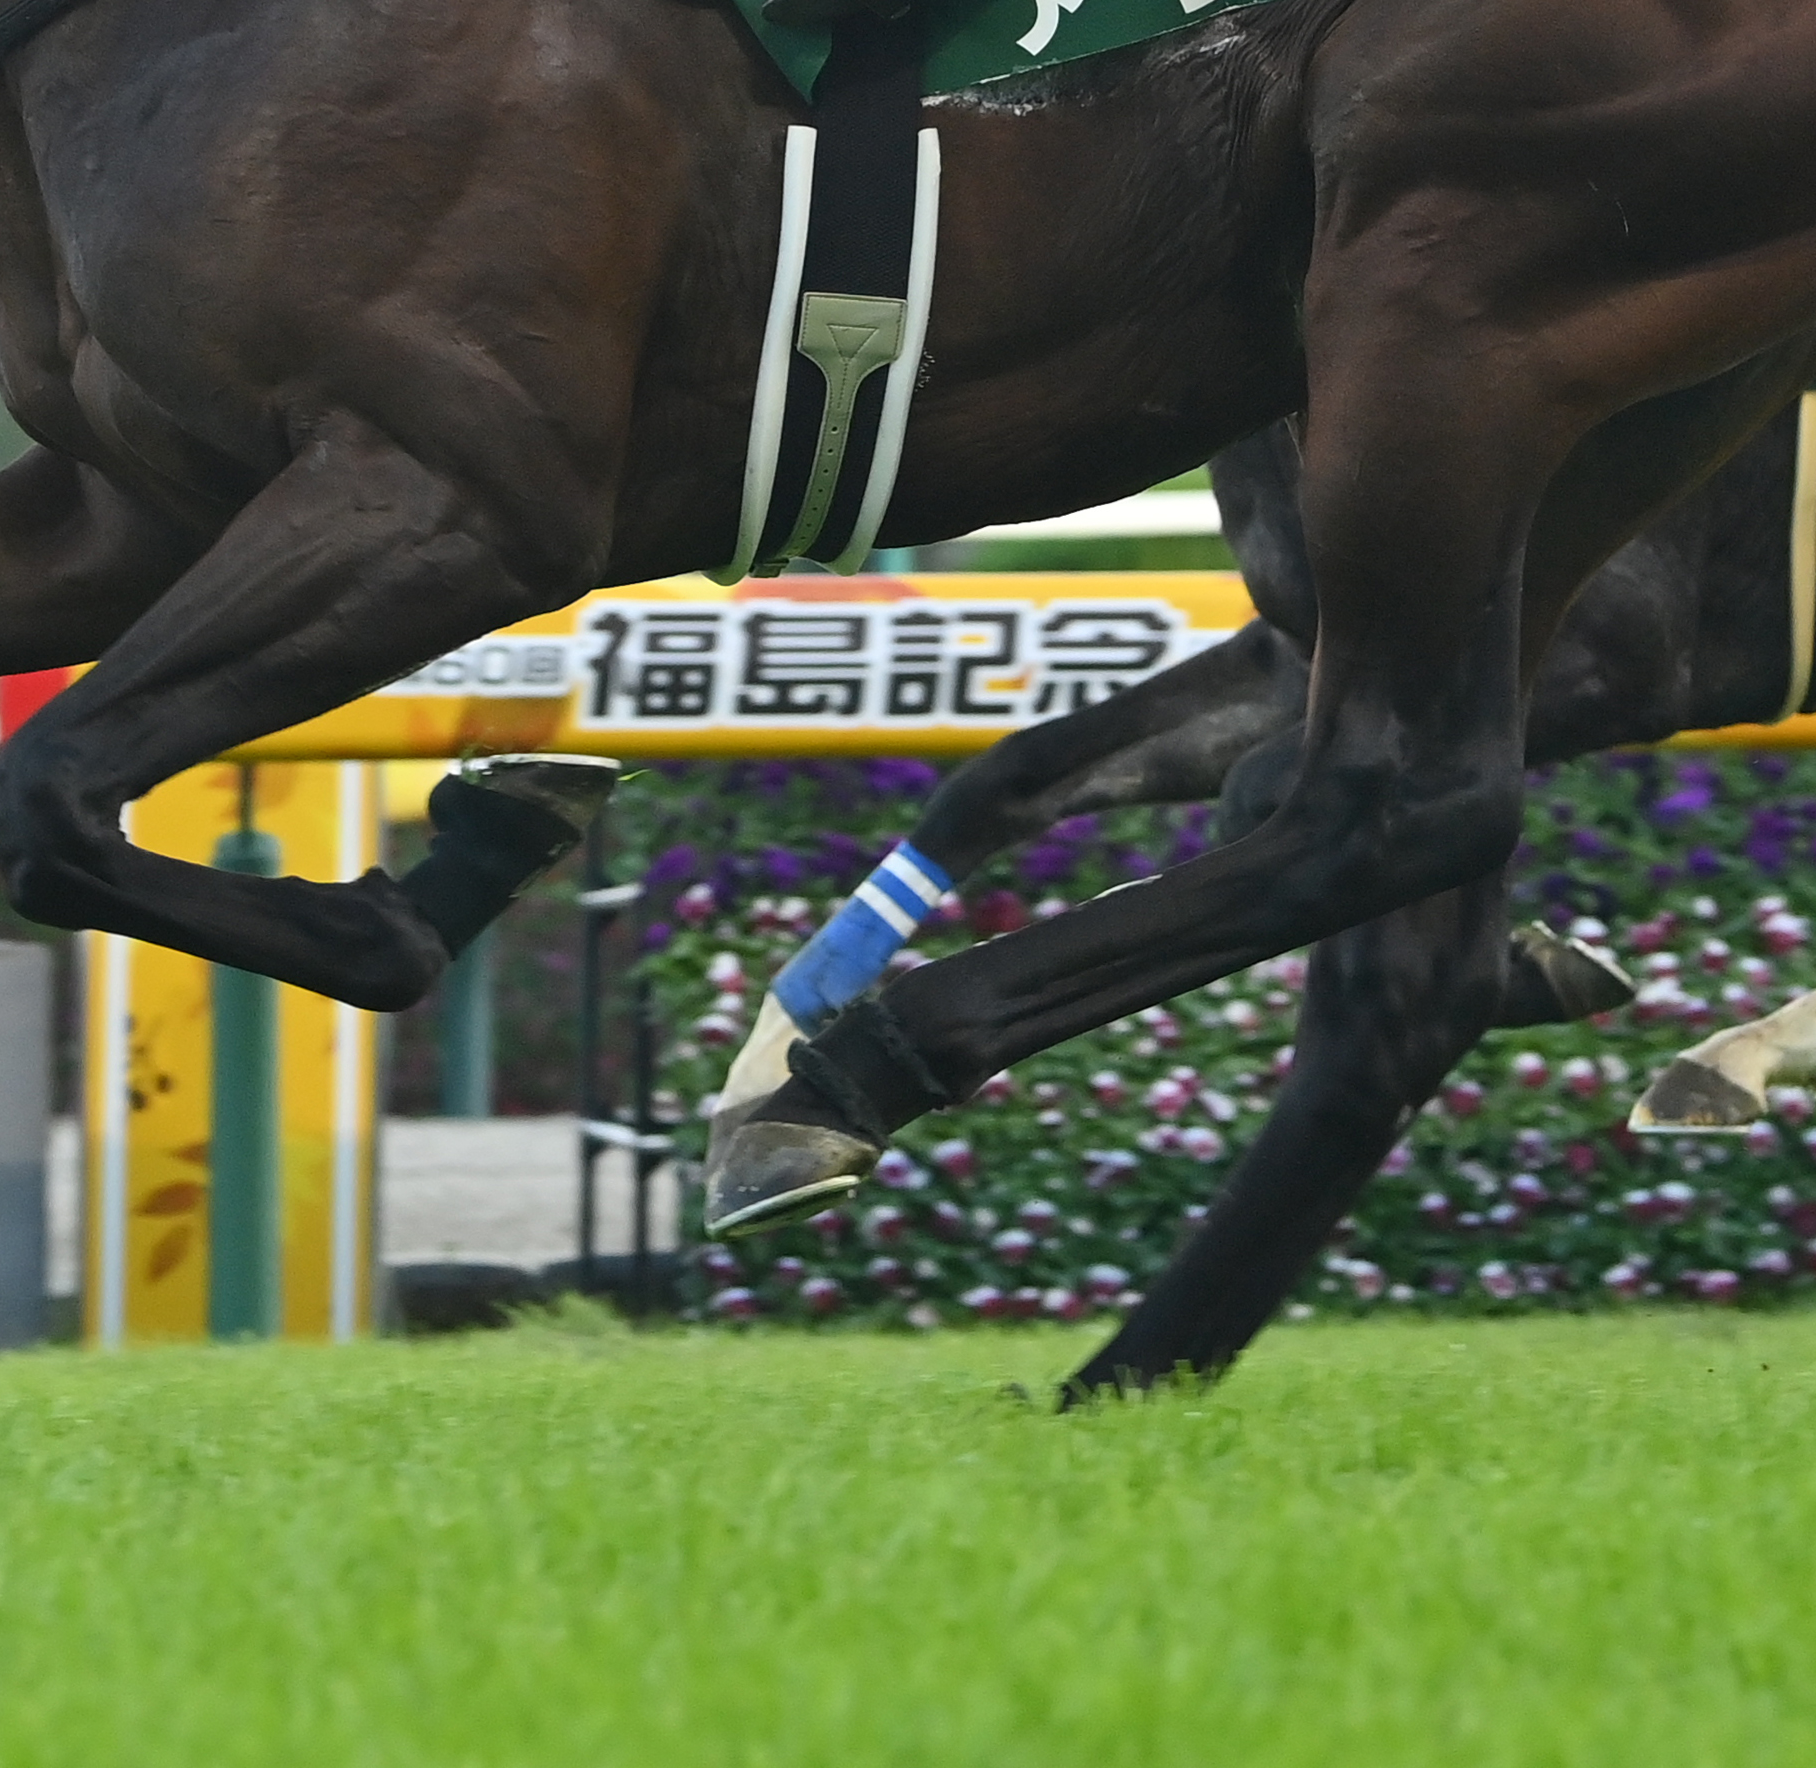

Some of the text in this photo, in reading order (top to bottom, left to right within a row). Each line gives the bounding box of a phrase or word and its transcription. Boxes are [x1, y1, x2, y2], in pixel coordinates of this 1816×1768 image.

[405, 609, 1171, 717] 60回 福島記念
